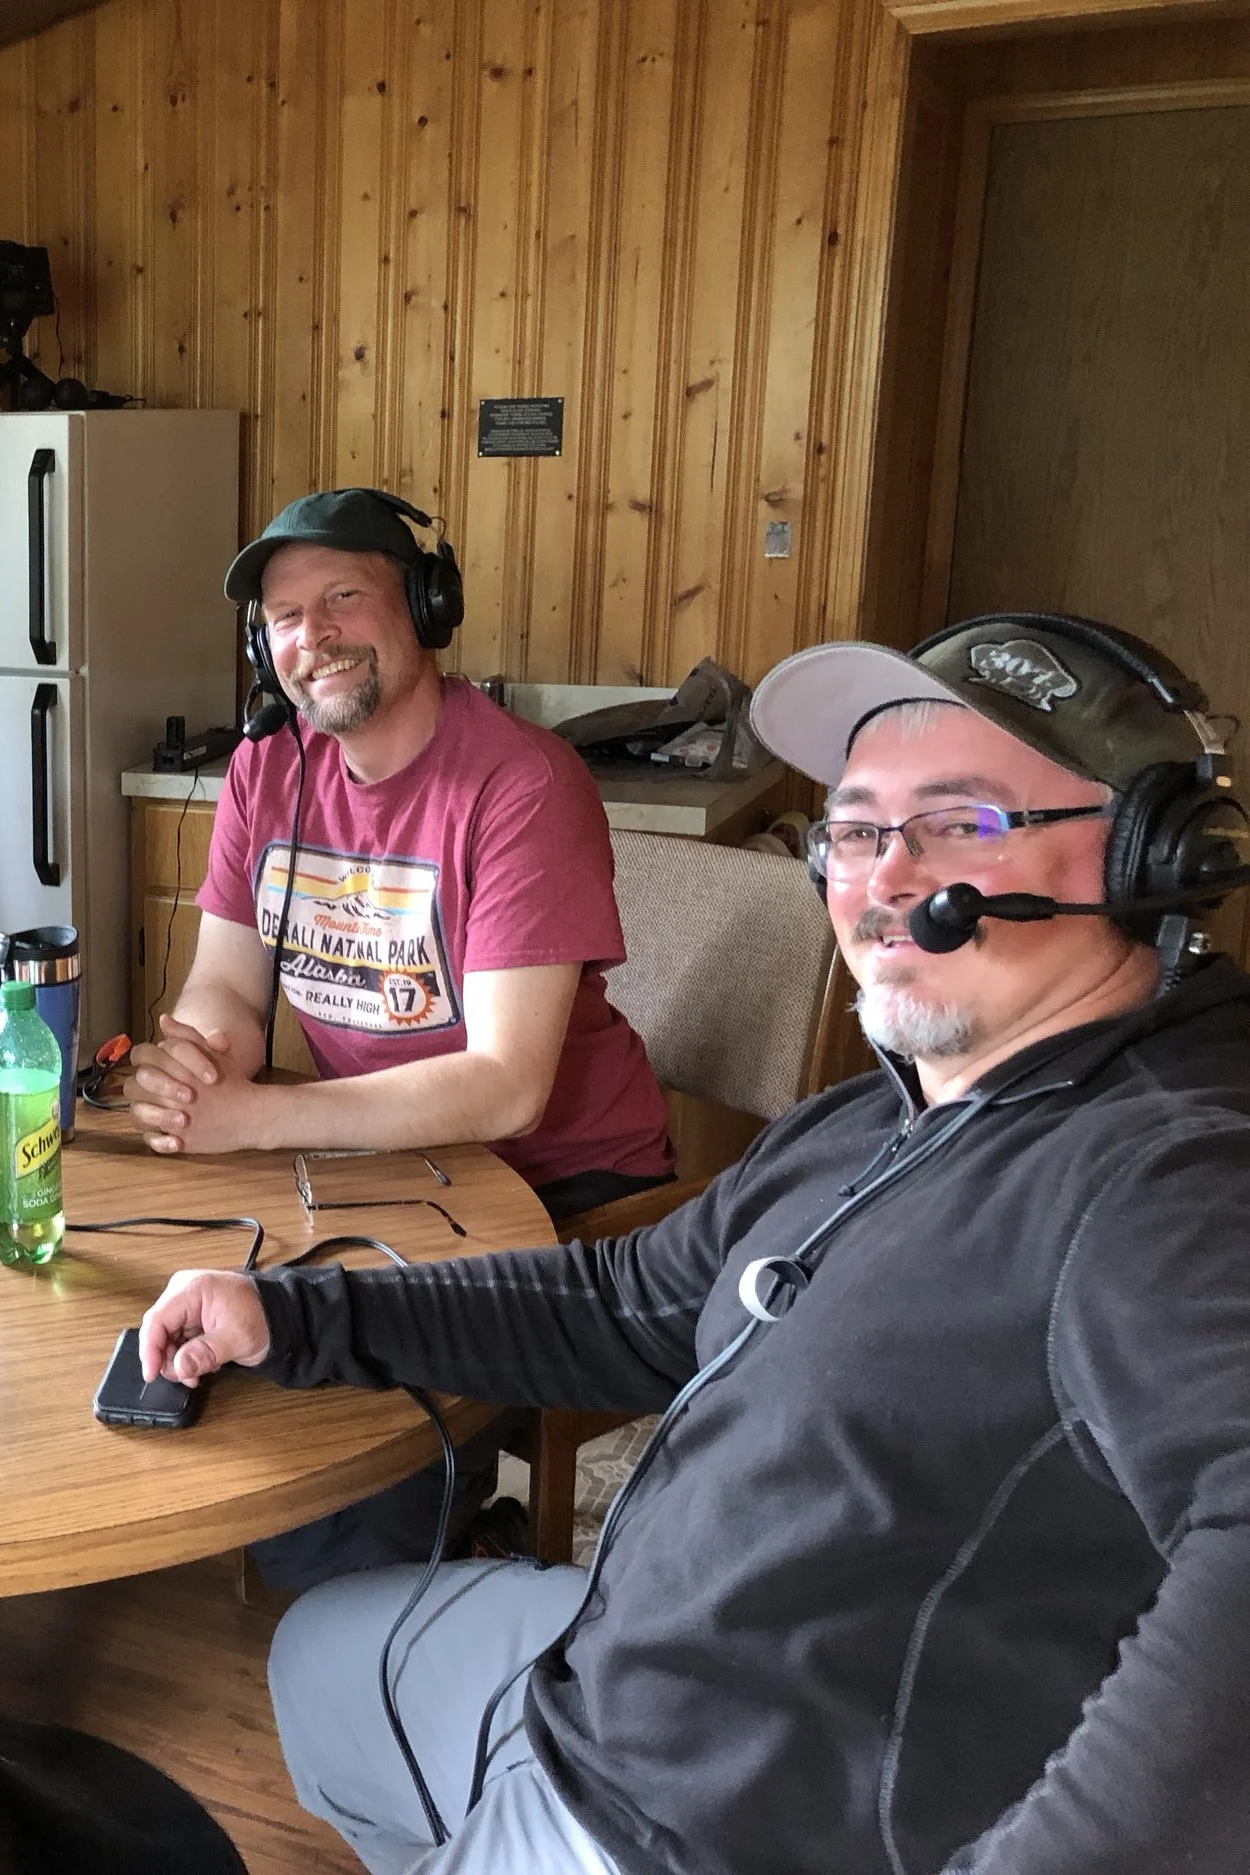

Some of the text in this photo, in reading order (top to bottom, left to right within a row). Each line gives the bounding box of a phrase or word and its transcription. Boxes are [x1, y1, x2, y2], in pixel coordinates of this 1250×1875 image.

[388, 935, 430, 966] PARK
[280, 953, 366, 987] Alaska
[305, 990, 354, 1009] REALLY
[355, 999, 381, 1016] HIGH
[388, 987, 416, 1012] 17
[23, 1197, 48, 1208] SODA
